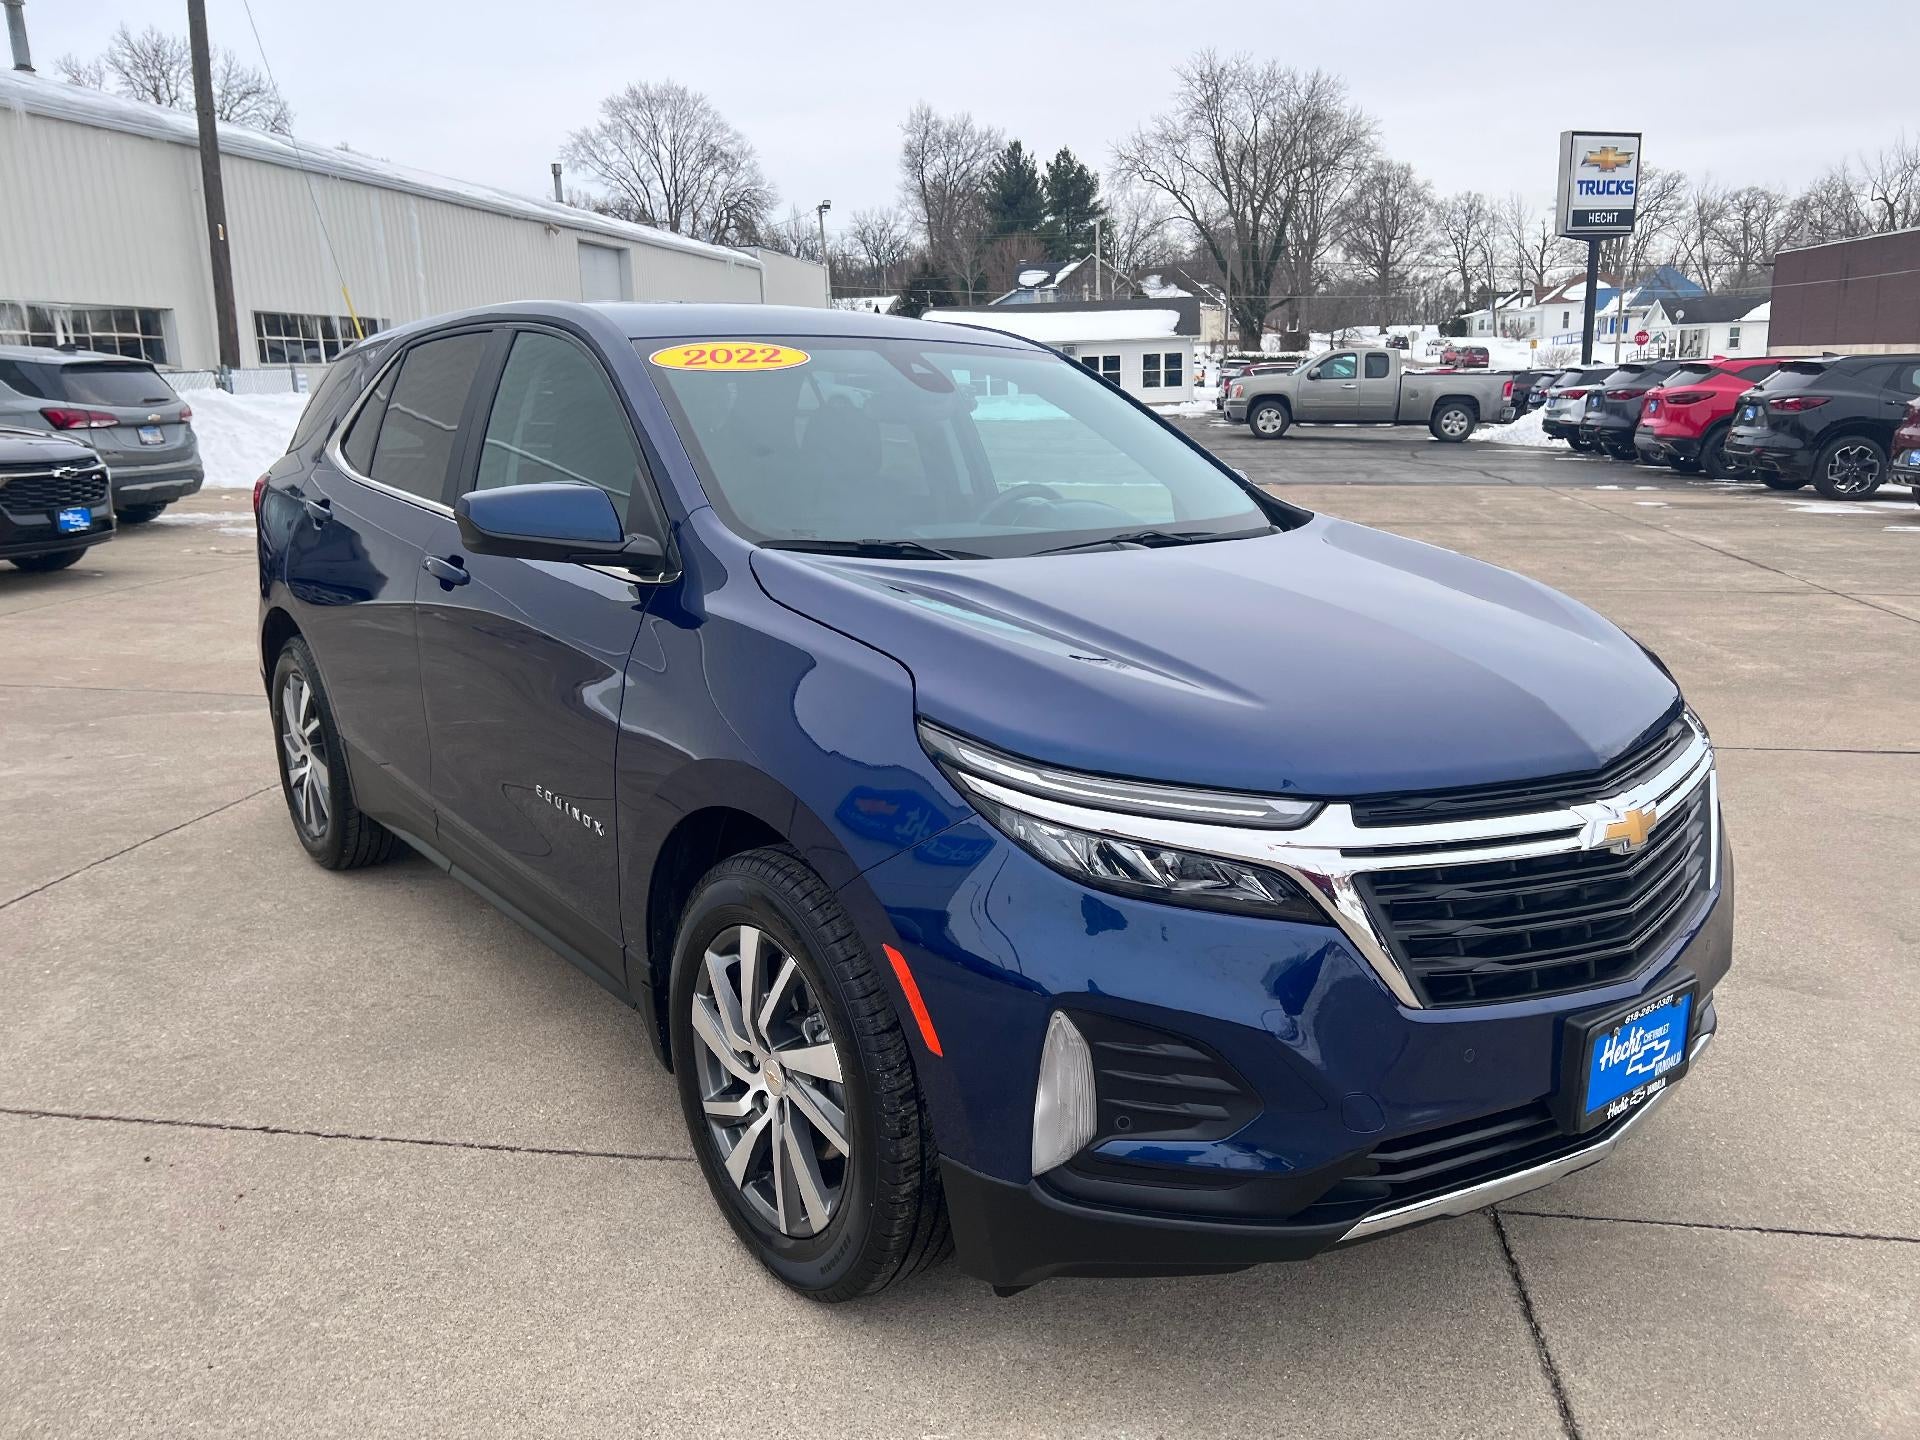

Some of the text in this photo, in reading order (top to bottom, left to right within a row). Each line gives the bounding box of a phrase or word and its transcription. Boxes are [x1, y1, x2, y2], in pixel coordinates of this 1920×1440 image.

[1577, 179, 1634, 195] TRUCKS
[1588, 212, 1619, 223] HECHT
[683, 348, 783, 366] 2022
[535, 784, 605, 836] EQUINOX
[1599, 1026, 1645, 1072] Hecht
[1606, 1096, 1630, 1120] Hecht
